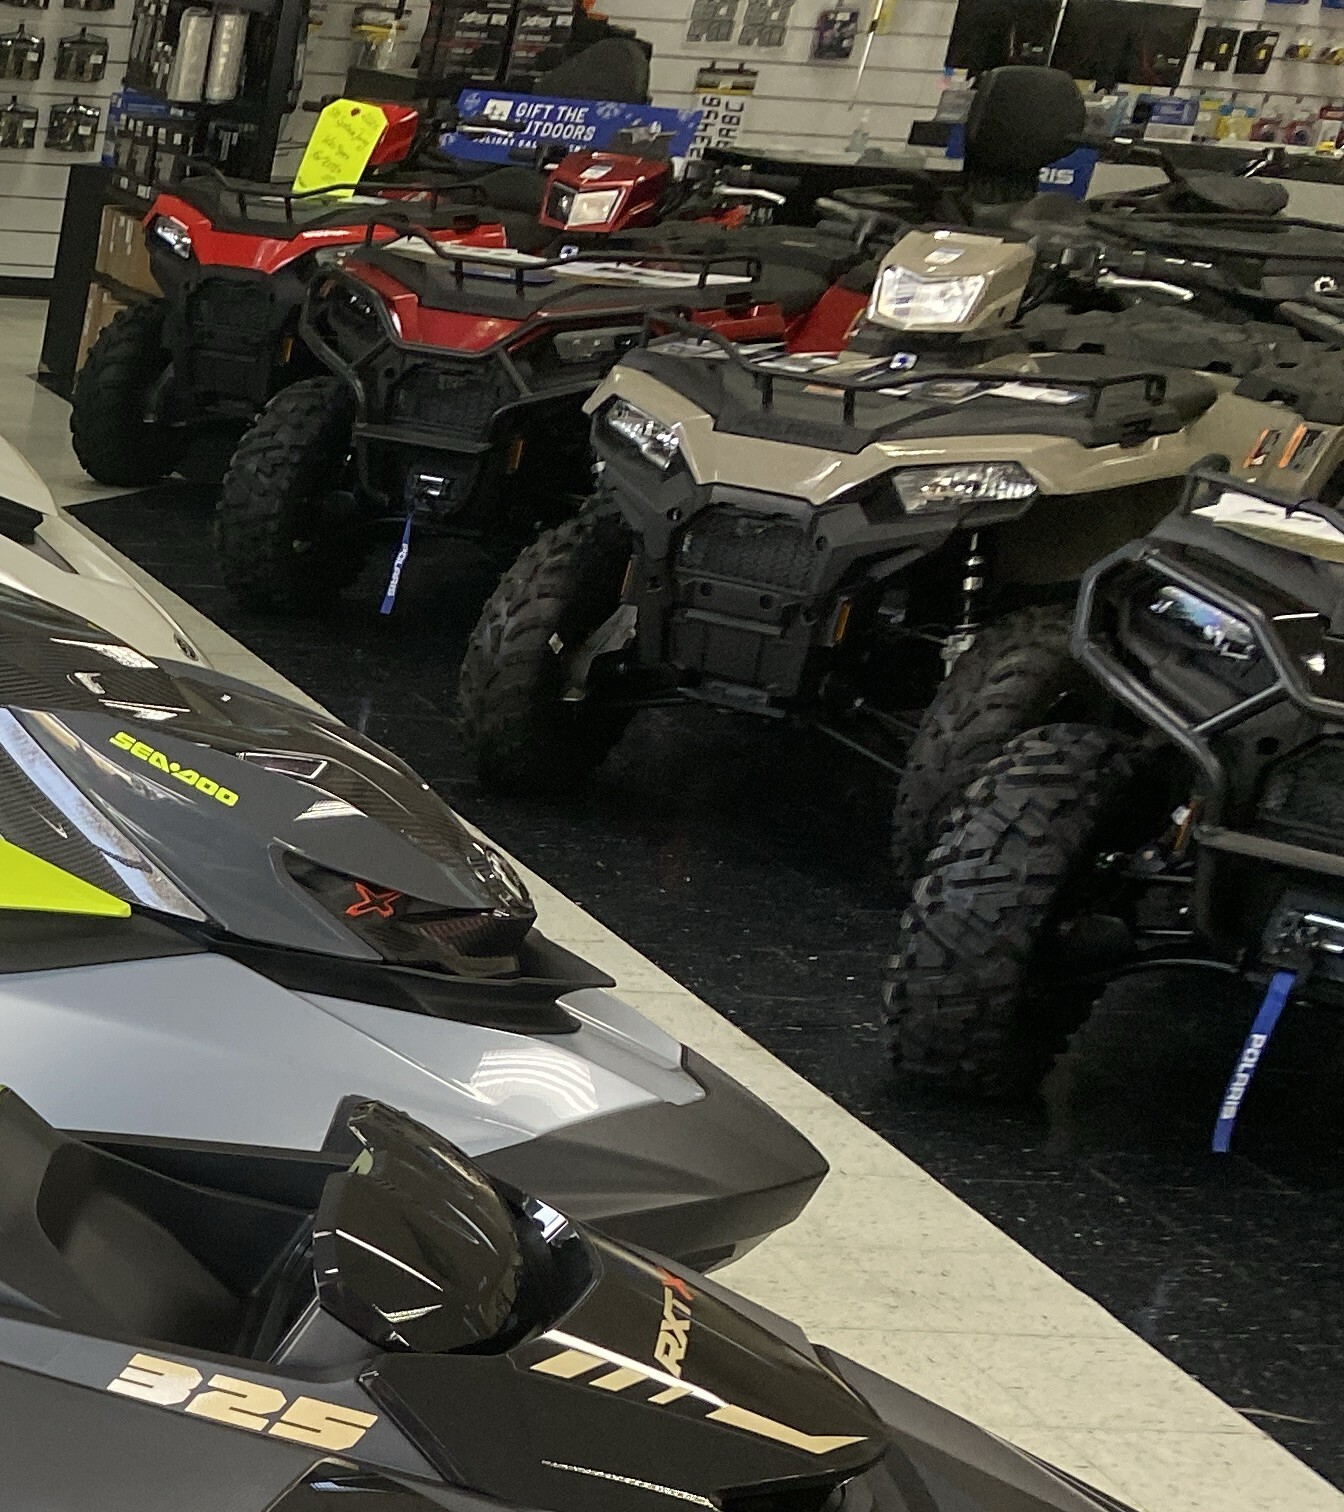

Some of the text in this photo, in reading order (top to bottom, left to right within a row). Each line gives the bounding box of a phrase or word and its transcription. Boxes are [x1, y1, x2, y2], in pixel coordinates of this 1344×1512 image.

[515, 101, 590, 123] GIFT THE
[1219, 1033, 1268, 1120] POLARIS
[107, 1353, 378, 1451] 325
